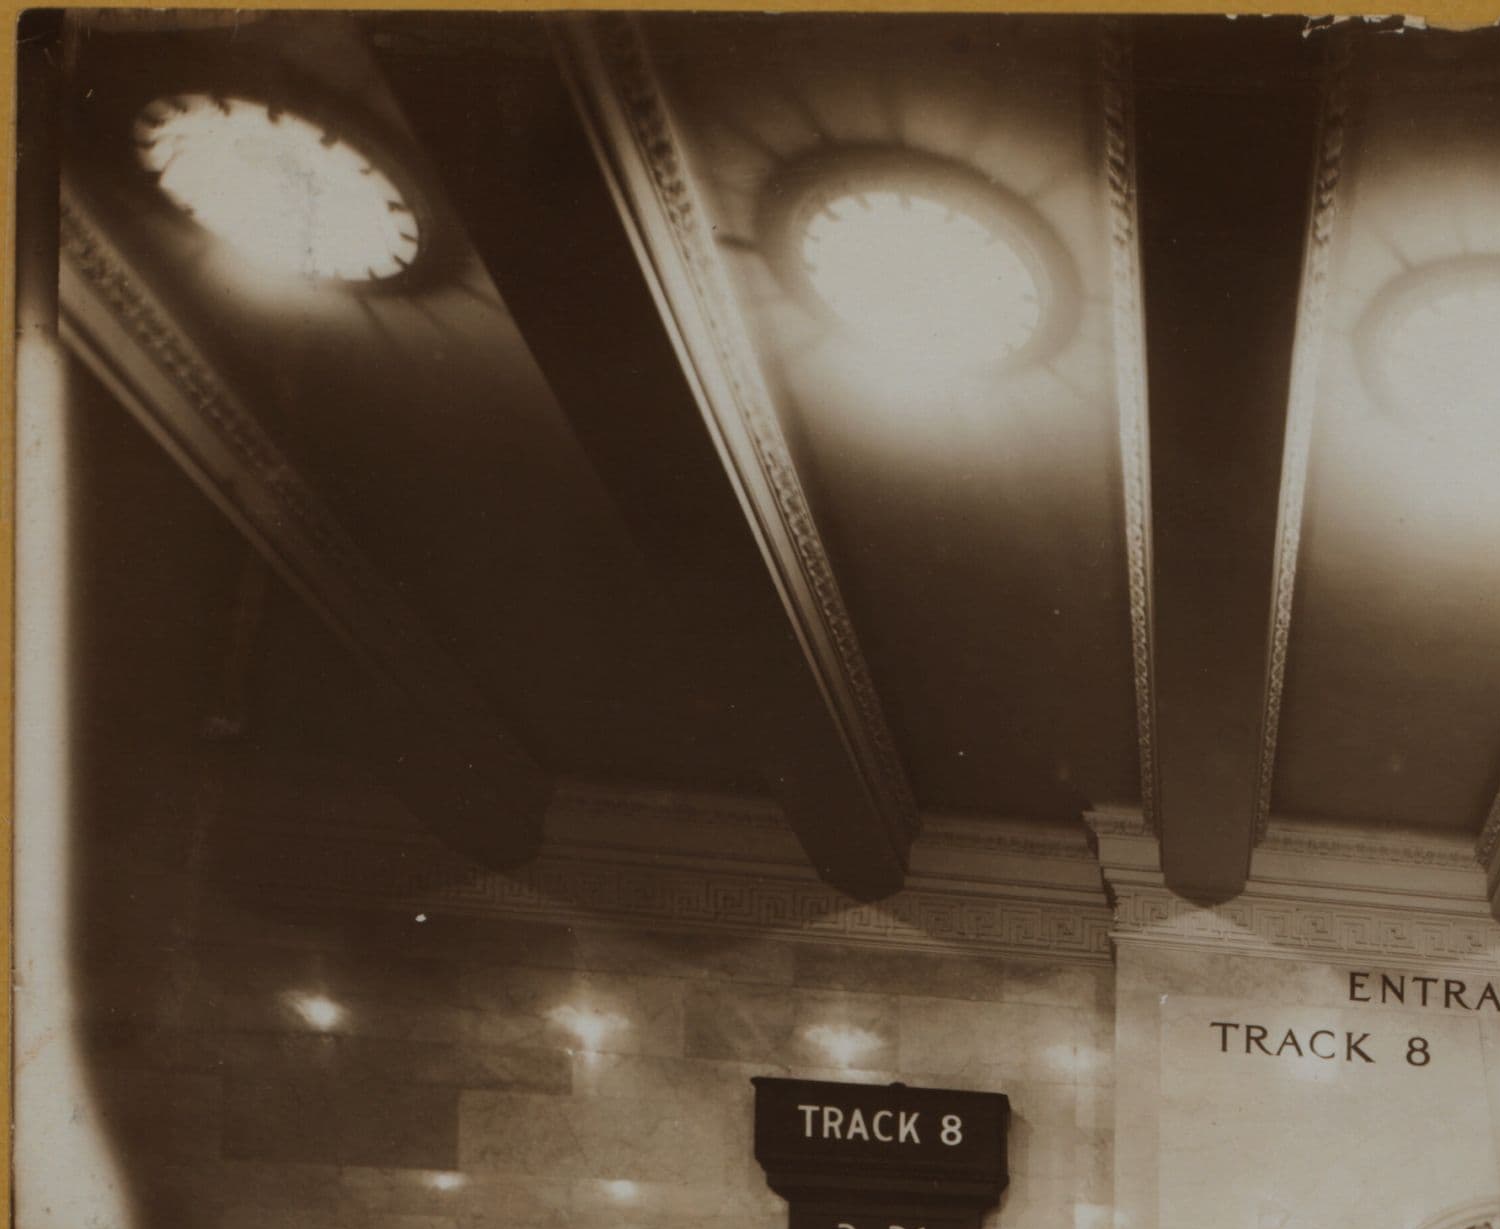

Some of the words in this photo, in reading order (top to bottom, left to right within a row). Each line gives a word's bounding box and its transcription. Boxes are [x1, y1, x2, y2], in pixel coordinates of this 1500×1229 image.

[1209, 1021, 1376, 1064] TRACK
[1405, 1037, 1431, 1066] 8
[798, 1104, 921, 1144] TRACK
[940, 1114, 963, 1146] 8
